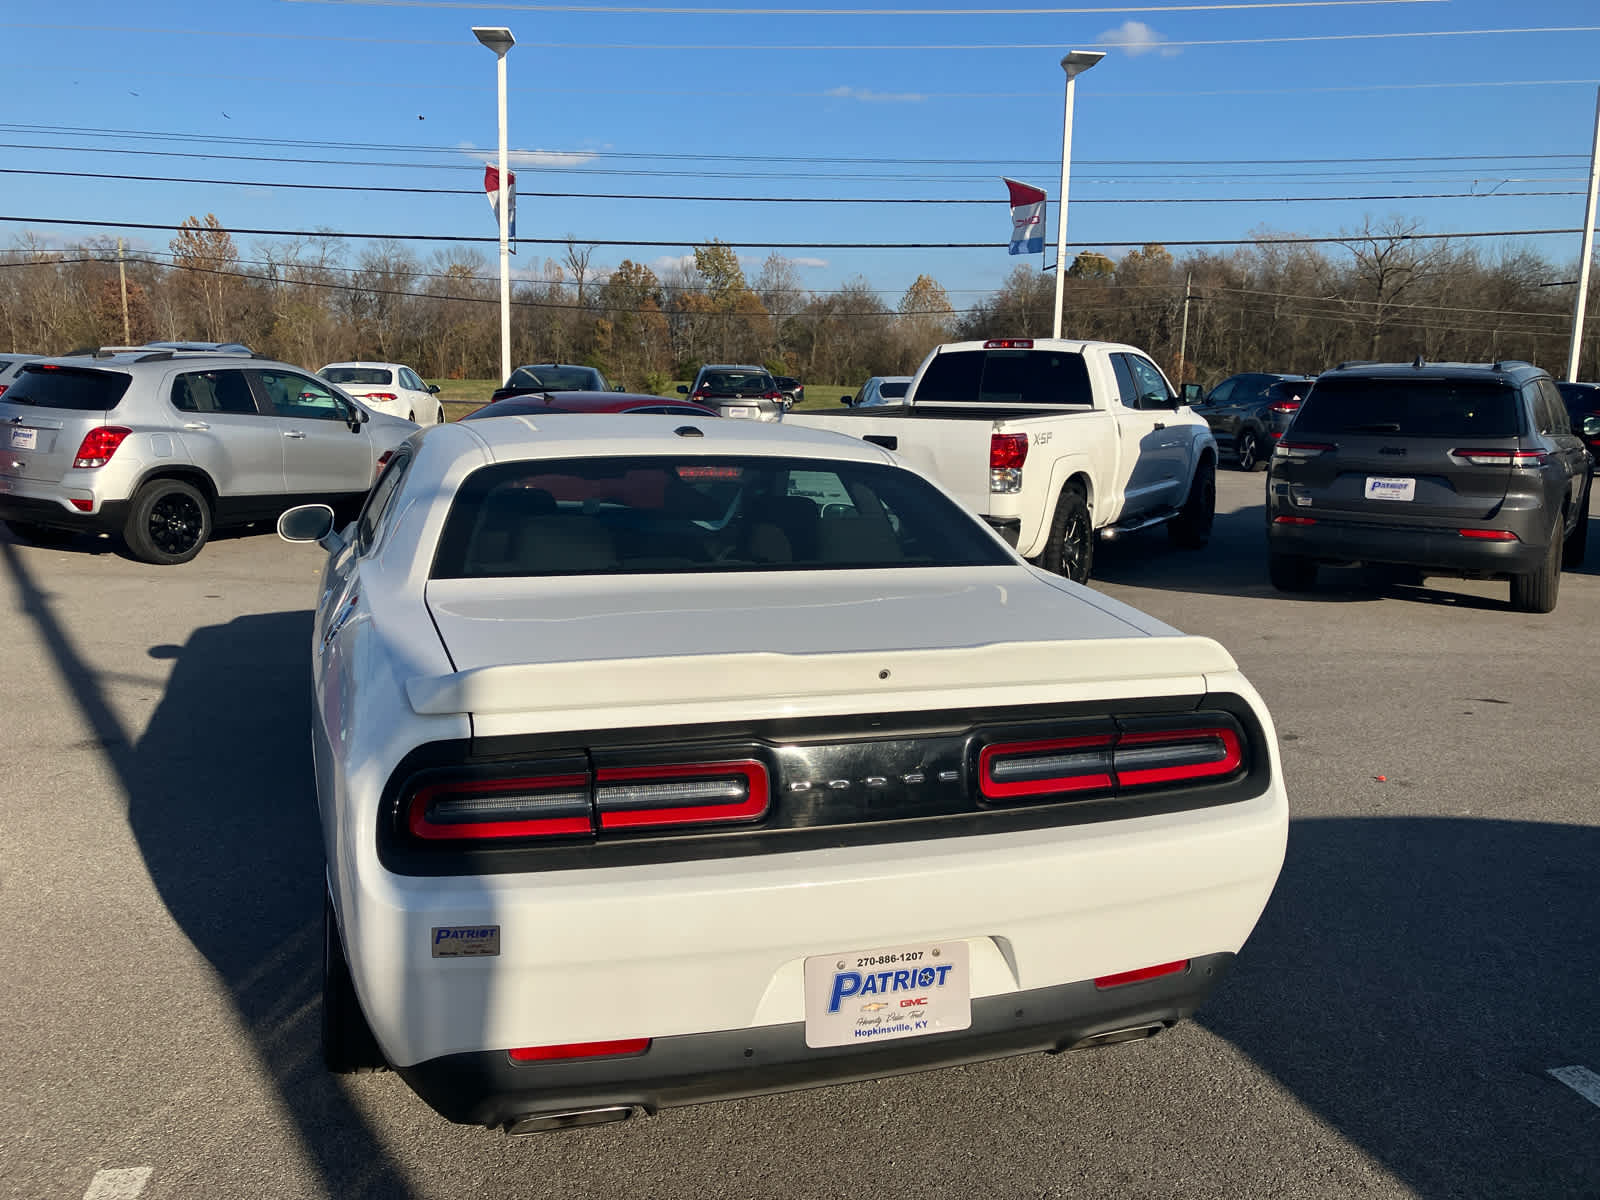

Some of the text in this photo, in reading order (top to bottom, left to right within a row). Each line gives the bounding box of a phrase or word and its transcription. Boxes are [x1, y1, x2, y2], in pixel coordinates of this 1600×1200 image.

[435, 928, 497, 945] PATRIOT
[857, 951, 924, 967] 270-886-1207
[827, 965, 953, 1014] PATRIOT
[900, 997, 928, 1008] GMC
[854, 1020, 928, 1037] Hopkinsville, KY
